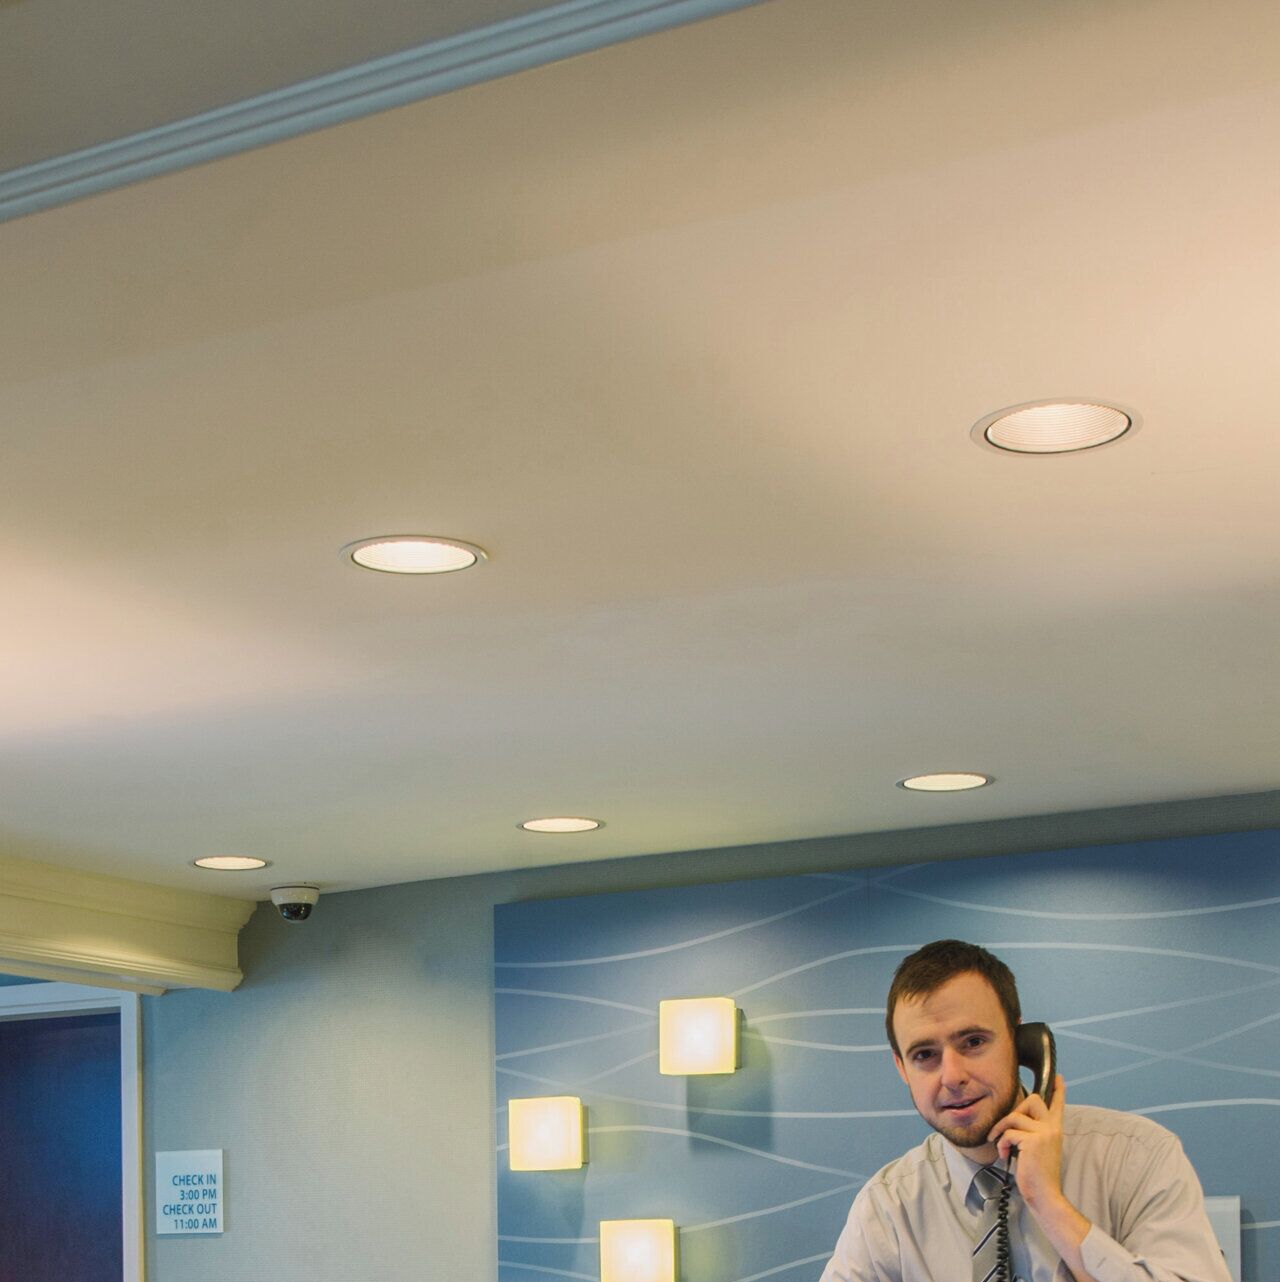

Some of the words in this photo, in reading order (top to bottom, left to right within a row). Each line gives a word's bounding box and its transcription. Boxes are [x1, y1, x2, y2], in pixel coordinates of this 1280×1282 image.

[172, 1174, 204, 1186] CHECK
[206, 1174, 217, 1185] IN
[180, 1190, 199, 1200] 3:00
[202, 1188, 217, 1199] PM
[163, 1204, 194, 1215] CHECK
[196, 1203, 217, 1214] OUT
[174, 1218, 199, 1230] 11:00
[202, 1218, 217, 1229] AM
